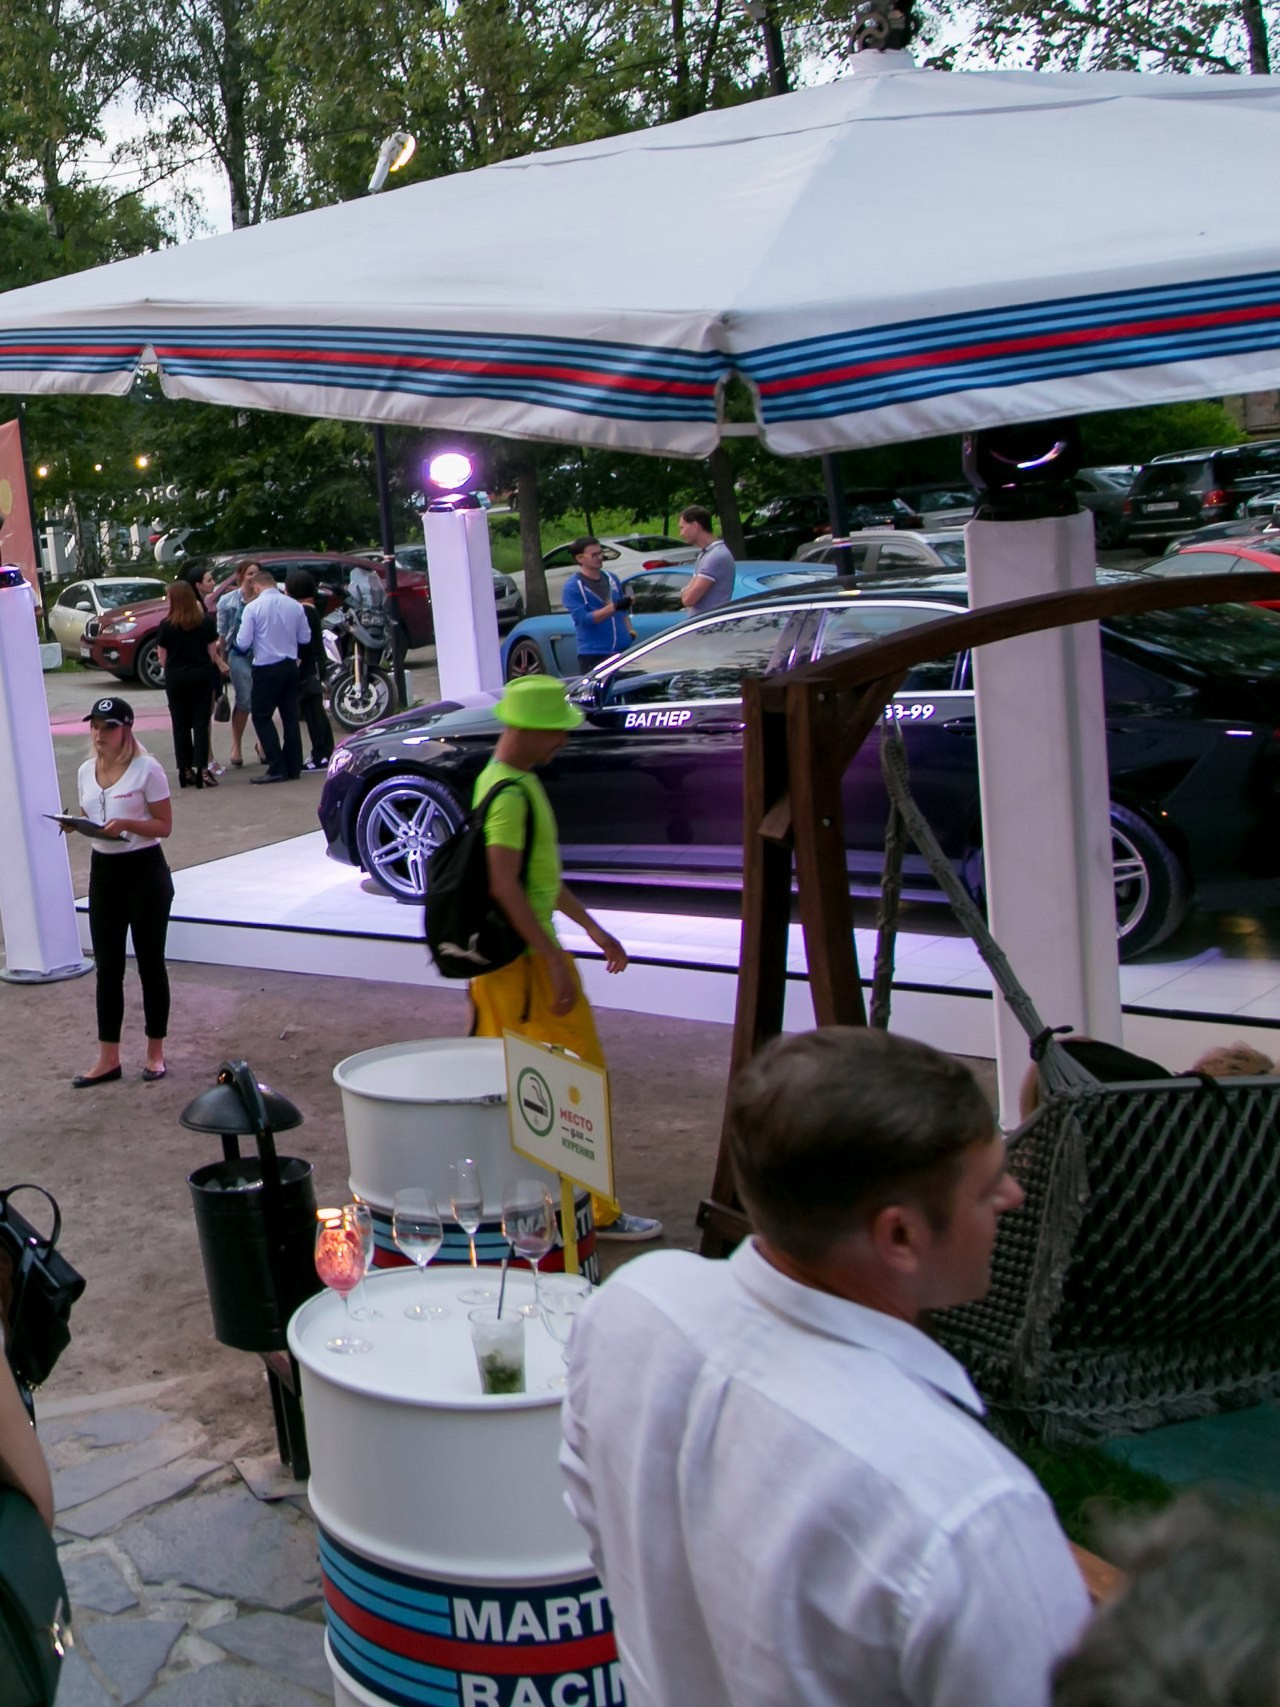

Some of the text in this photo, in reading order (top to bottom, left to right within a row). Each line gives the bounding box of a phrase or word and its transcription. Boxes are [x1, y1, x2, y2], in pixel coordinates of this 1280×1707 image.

[625, 710, 691, 728] ВАГНЕР
[560, 1108, 593, 1132] МЕСТО
[561, 1136, 595, 1161] КУРЕНИЯ
